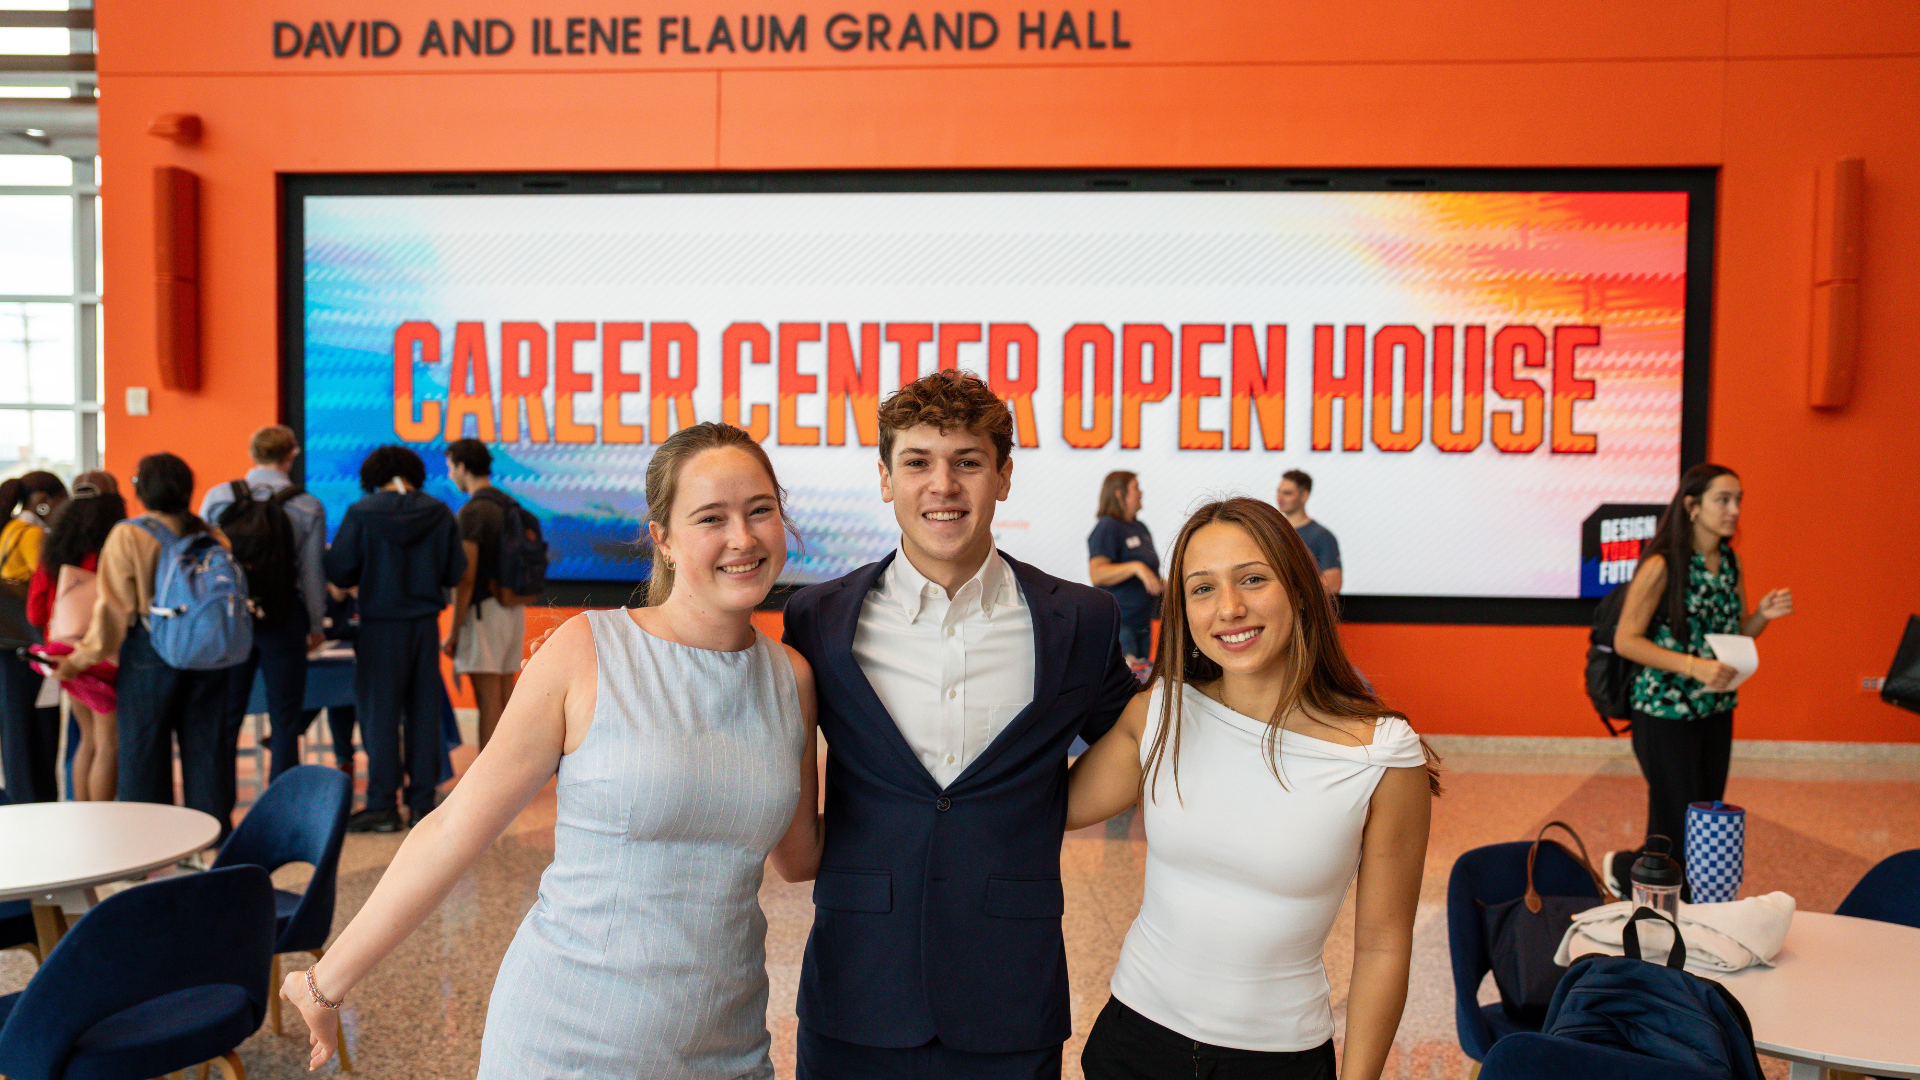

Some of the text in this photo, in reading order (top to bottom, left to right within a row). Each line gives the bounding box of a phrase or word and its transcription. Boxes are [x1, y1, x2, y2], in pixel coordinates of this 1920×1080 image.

[272, 10, 1131, 58] DAVID AND ILENE FLAUM GRAND HALL
[393, 320, 698, 445] CAREER
[1062, 323, 1288, 450] OPEN
[1311, 325, 1600, 453] HOUSE
[1600, 515, 1656, 542] DESIGN
[1600, 539, 1640, 561] YOUR
[1599, 559, 1638, 584] FUTU
